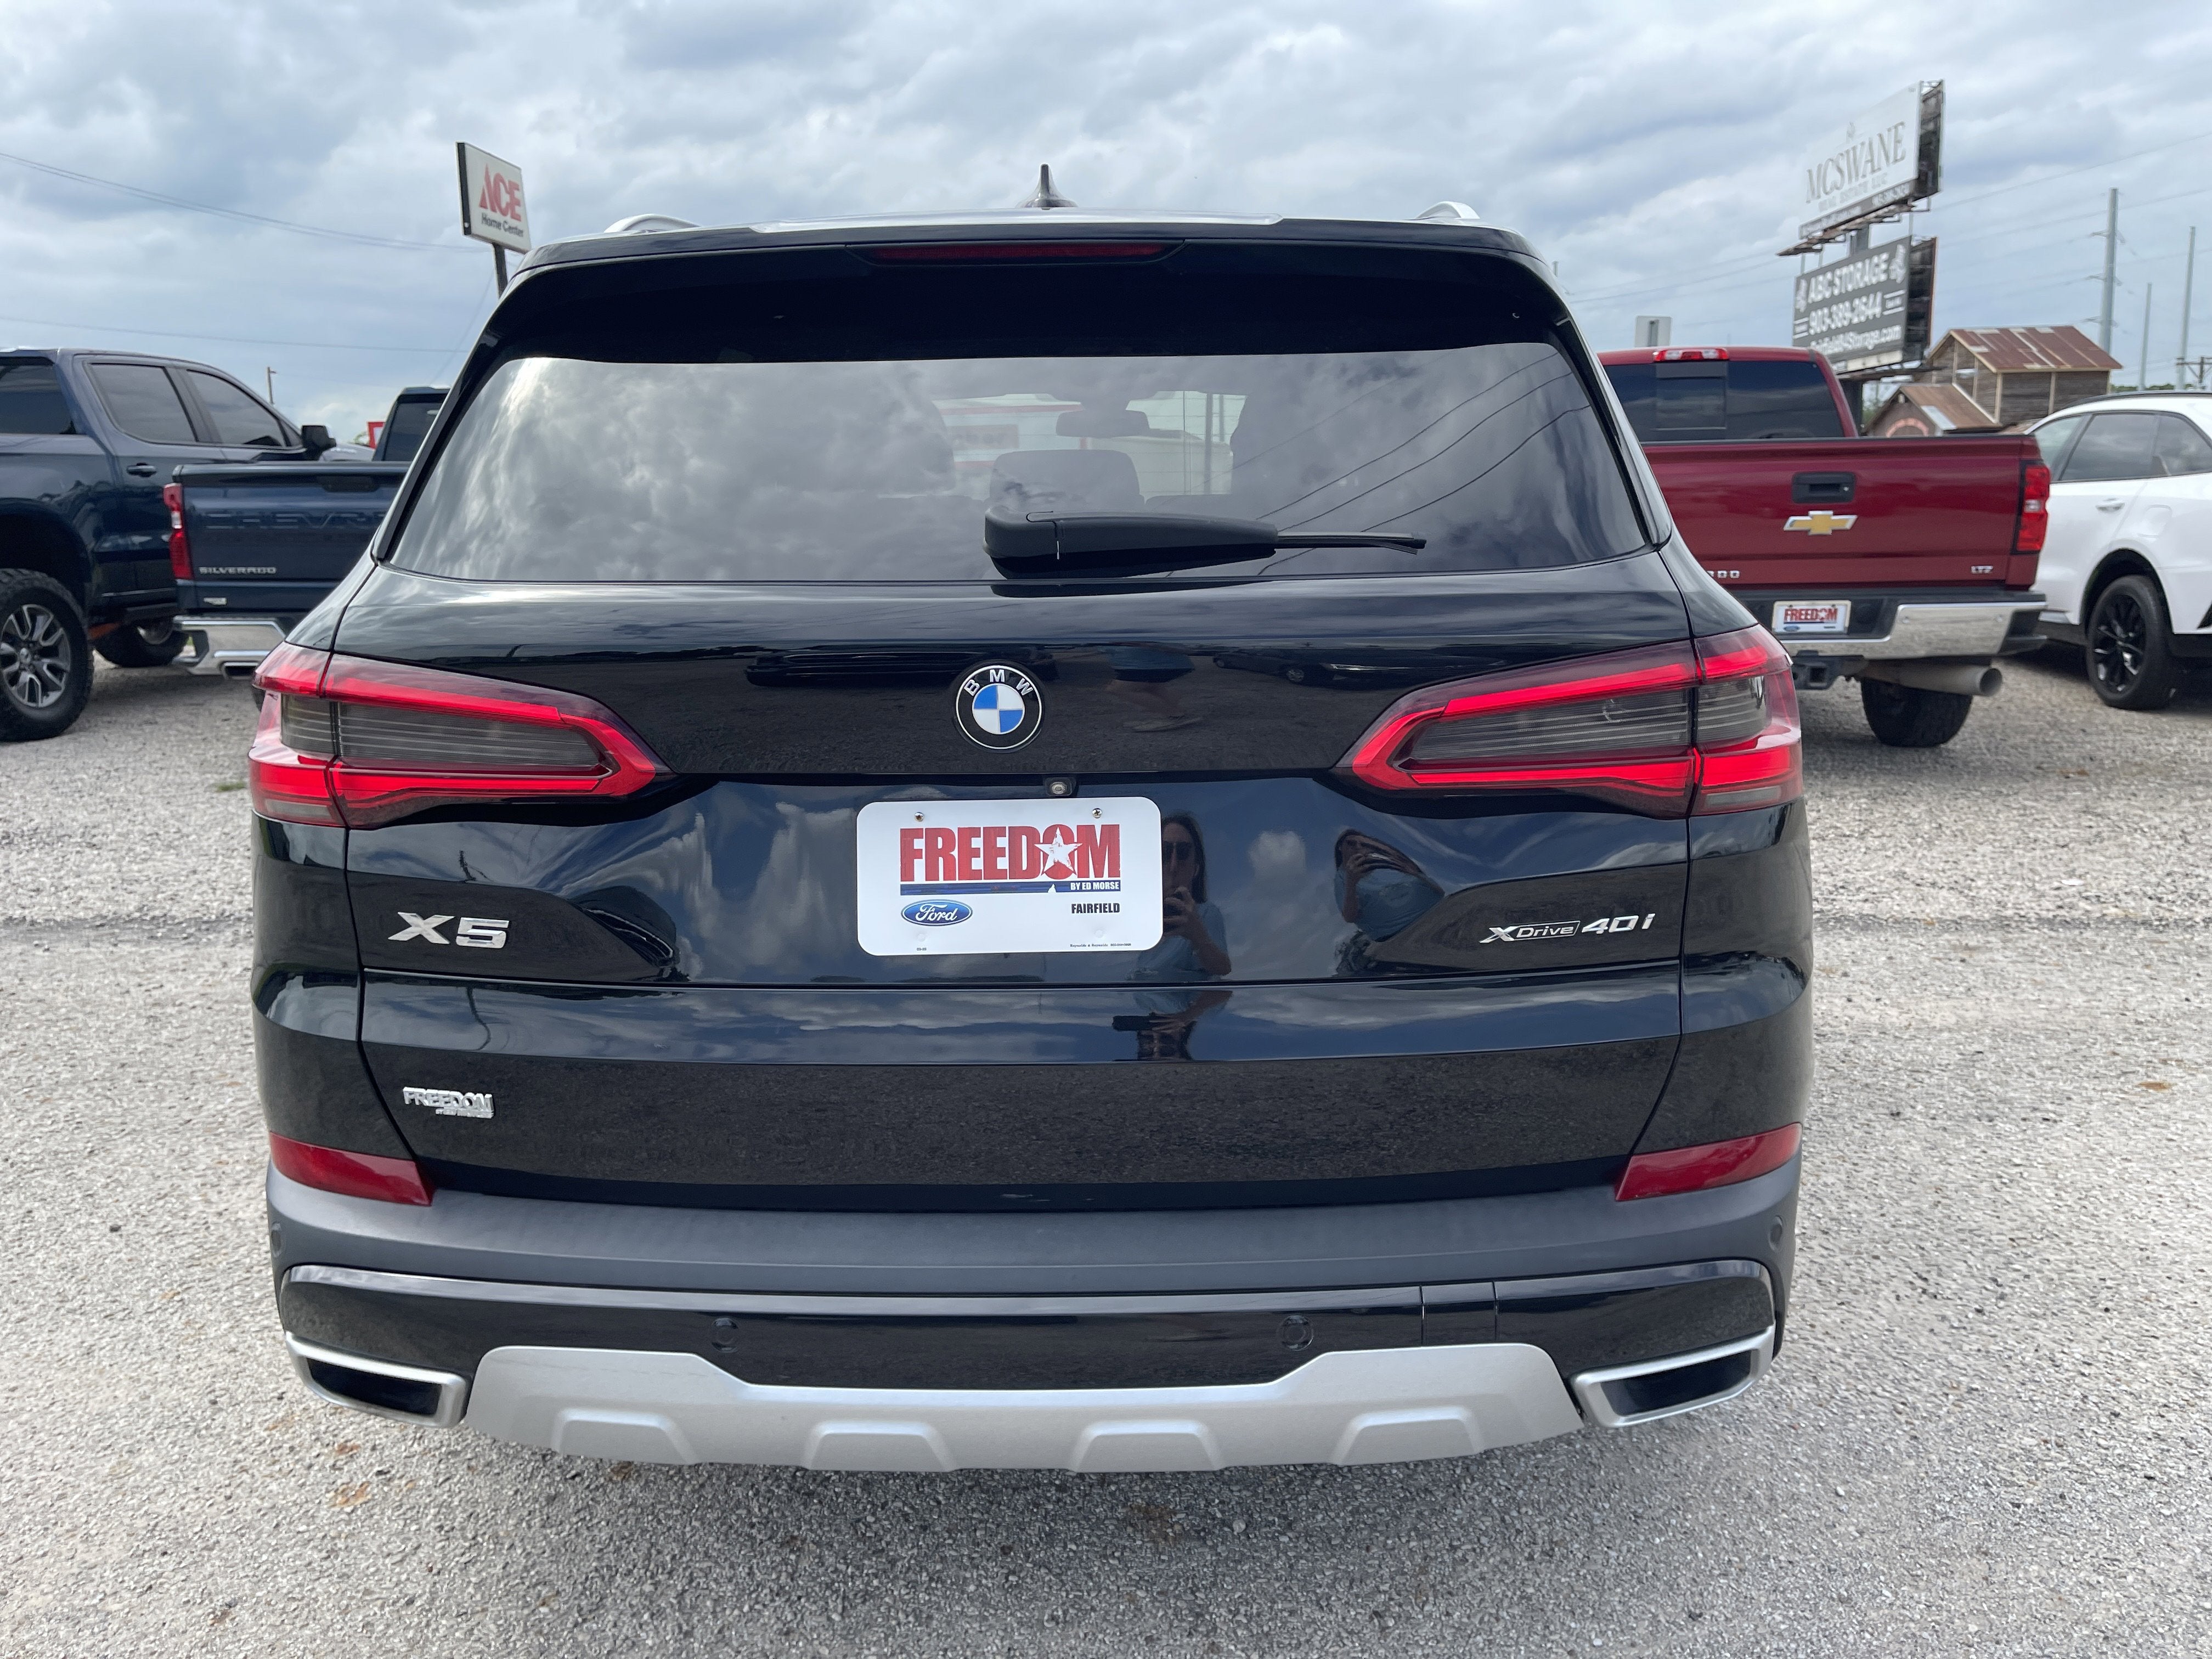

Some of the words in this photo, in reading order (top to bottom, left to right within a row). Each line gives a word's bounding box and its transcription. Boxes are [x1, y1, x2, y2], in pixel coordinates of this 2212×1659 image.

[1805, 121, 1906, 204] MCSWANE
[478, 163, 522, 222] ACE
[481, 213, 501, 230] Home
[503, 221, 524, 238] Center
[1808, 270, 1833, 303] ABC
[1833, 252, 1890, 296] STORAGE
[199, 566, 276, 575] SILVERADO
[1971, 565, 1994, 574] LTZ
[1784, 608, 1838, 622] FREEDOM
[964, 669, 1034, 696] BMW
[900, 824, 1121, 882] FREEDOM
[1070, 882, 1081, 890] BY
[1093, 882, 1119, 890] MORSE
[915, 903, 958, 921] Ford
[1071, 902, 1120, 914] FAIRFIELD
[387, 912, 510, 949] X5
[403, 1086, 493, 1110] FREEDOM
